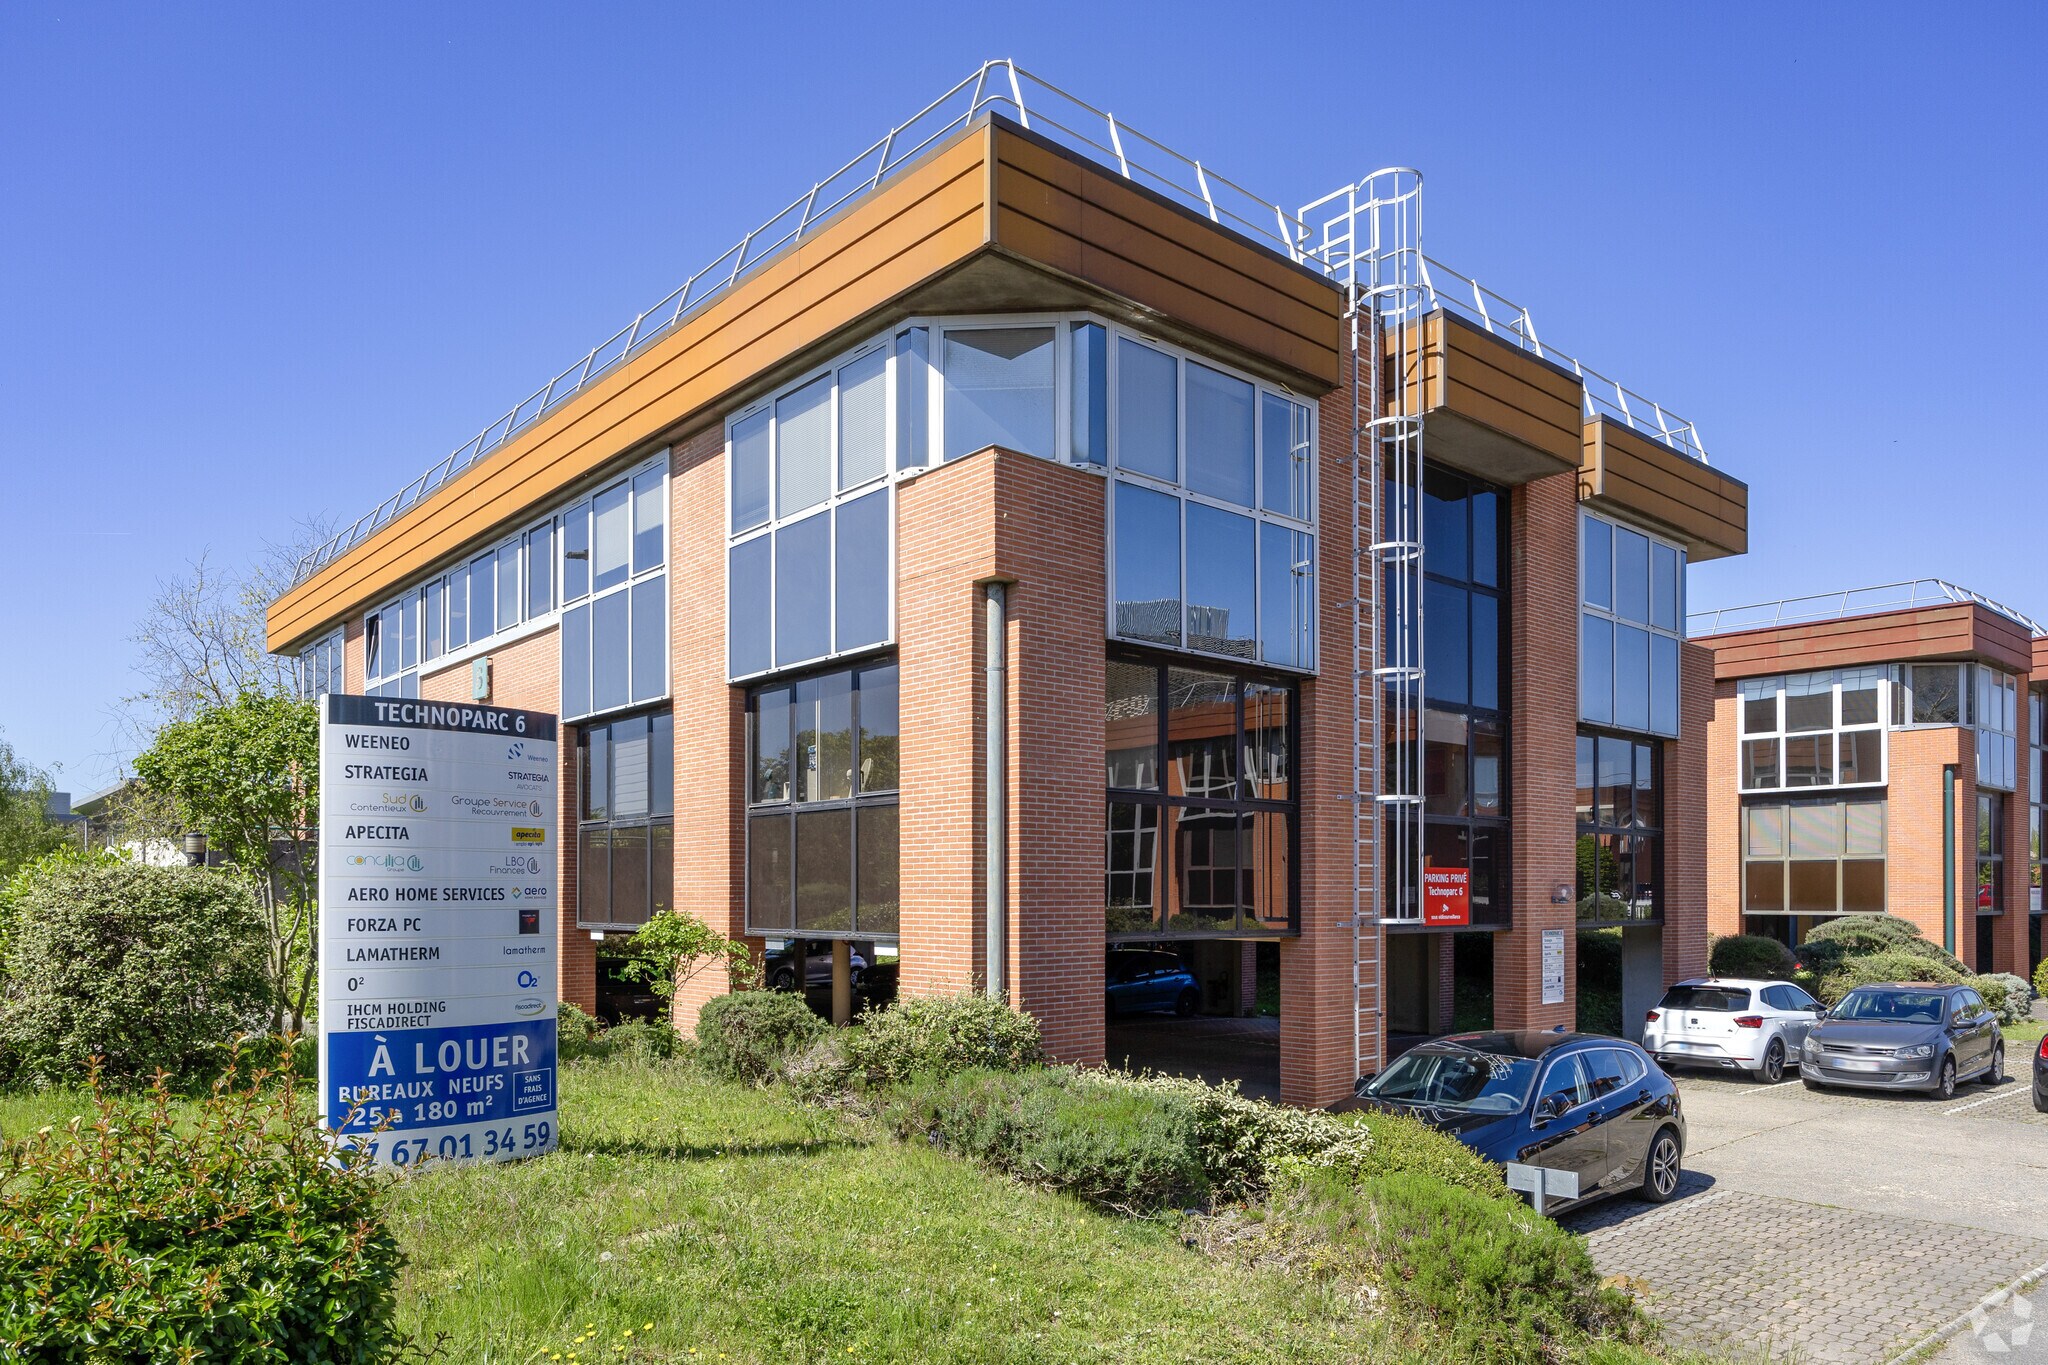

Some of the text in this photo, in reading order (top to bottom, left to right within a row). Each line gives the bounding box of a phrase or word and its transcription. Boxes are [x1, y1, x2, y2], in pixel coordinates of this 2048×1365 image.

[374, 702, 526, 733] TECHNOPARC 6
[345, 734, 410, 751] WEENEO
[527, 754, 549, 763] Weeneo
[345, 765, 429, 782] STRATEGIA
[508, 771, 550, 783] STRATEGIA
[516, 783, 543, 792] AVOCATS
[382, 792, 407, 804] Sud
[451, 795, 527, 809] Groupe Service
[350, 802, 407, 813] Contentieux
[471, 806, 527, 818] Recouvrement
[345, 825, 410, 840] APECITA
[505, 856, 526, 867] LBO
[489, 865, 526, 875] Finances
[1424, 871, 1467, 883] PARKING PRIVÉ
[348, 887, 505, 901] AERO HOME SERVICES
[524, 887, 548, 896] aero
[1428, 886, 1463, 898] Technoparc 6
[348, 918, 421, 932] FORZA PC
[347, 946, 440, 962] LAMATHERM
[503, 945, 546, 955] lamatherm
[347, 1001, 446, 1016] IHCM HOLDING
[347, 1015, 431, 1030] FISCADIRECT
[368, 1034, 530, 1077] À LOUER
[525, 1074, 541, 1083] SANS
[339, 1074, 504, 1103] BUREAUX NEUFS
[523, 1084, 543, 1094] FRAIS
[518, 1093, 548, 1105] D'AGENCE
[353, 1107, 383, 1126] 25
[414, 1100, 458, 1121] 180
[391, 1138, 429, 1166] 67
[439, 1134, 474, 1160] 01
[484, 1127, 516, 1155] 34
[523, 1121, 550, 1149] 59
